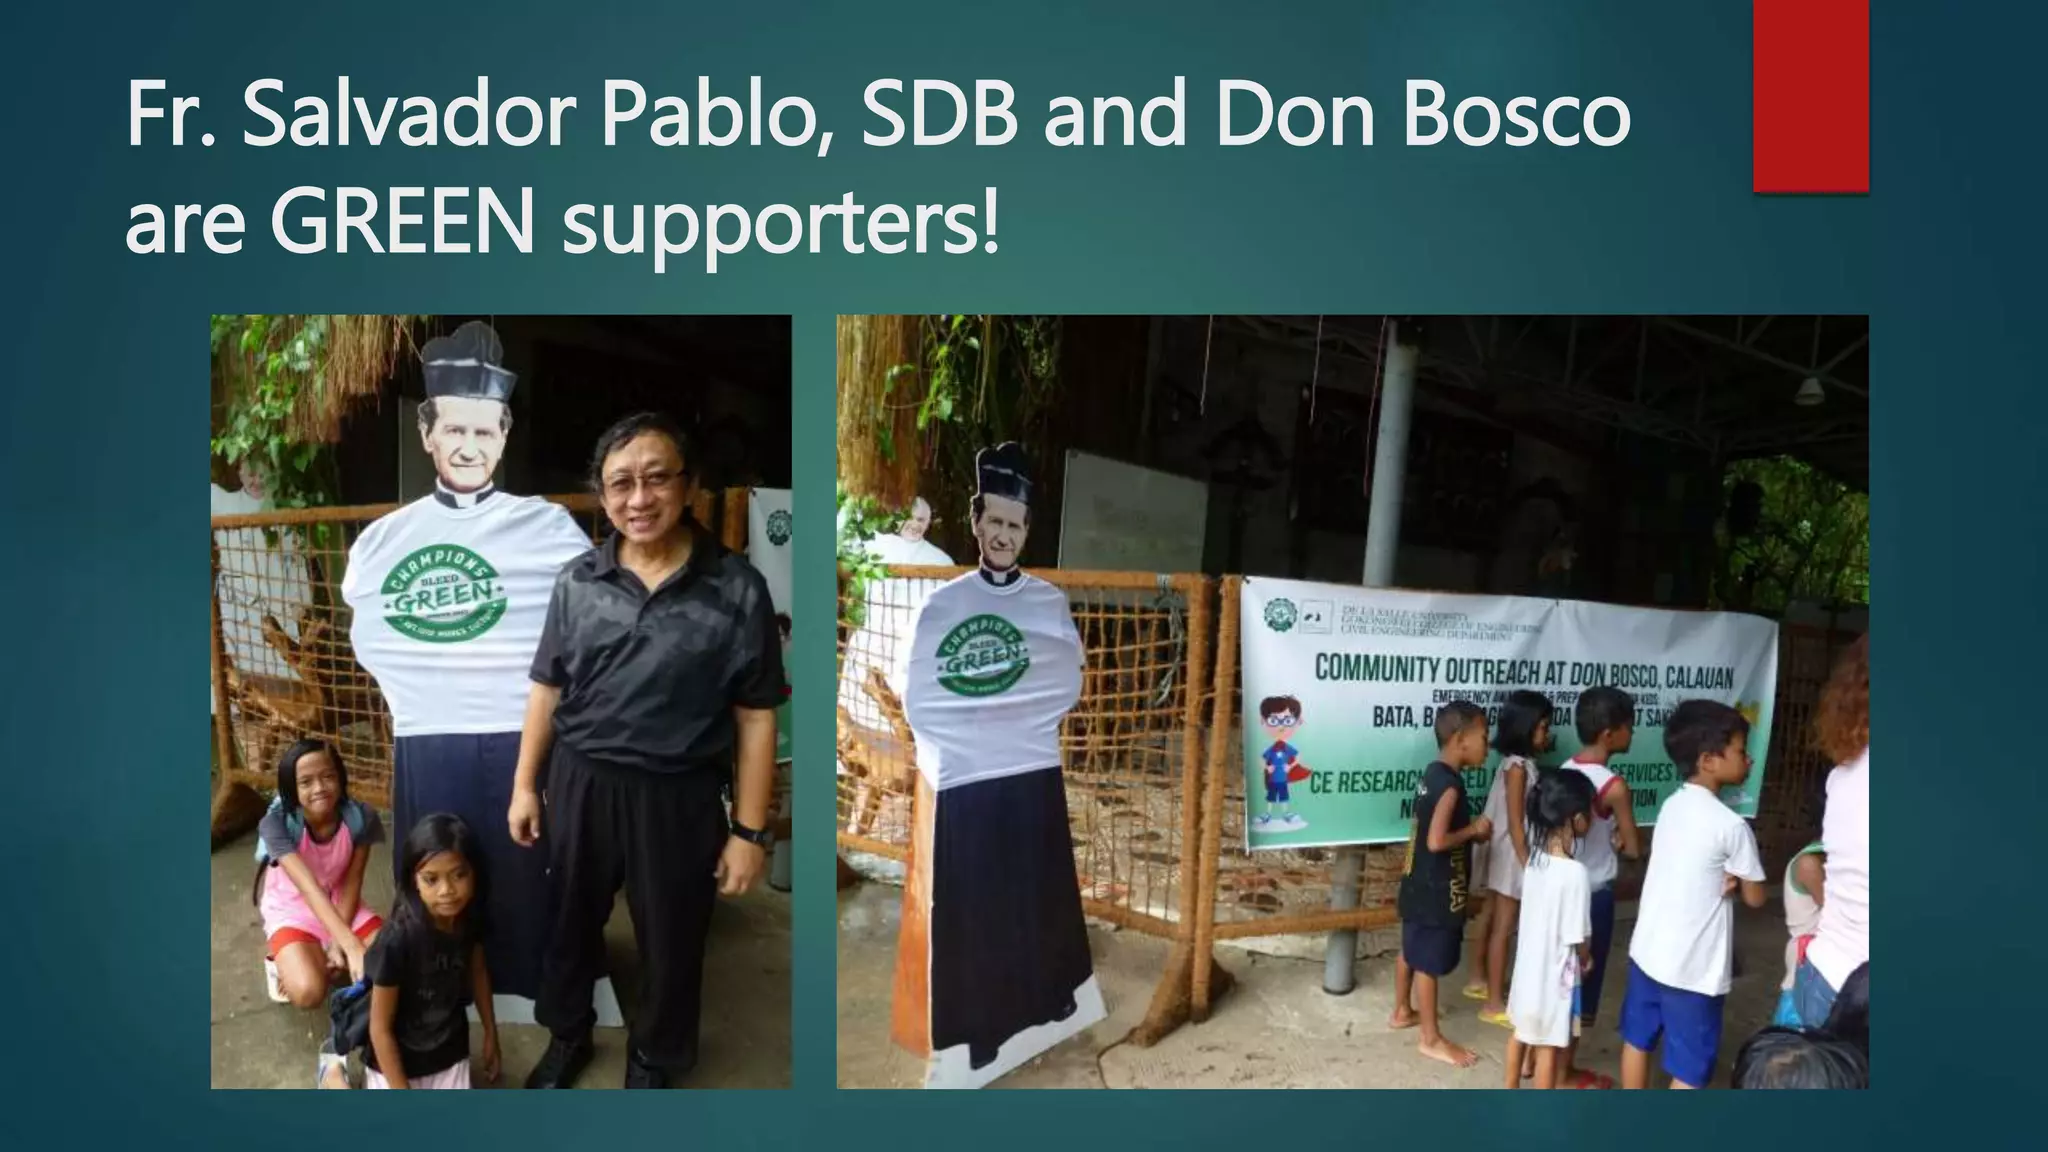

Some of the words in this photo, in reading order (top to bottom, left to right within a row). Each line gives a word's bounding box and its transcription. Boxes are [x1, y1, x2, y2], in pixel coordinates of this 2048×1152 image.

[390, 549, 489, 590] CHAMPIONS
[394, 580, 492, 614] GREEN
[946, 643, 1020, 673] GREEN
[1315, 652, 1441, 682] COMMUNITY
[1445, 657, 1541, 685] OUTREACH
[1544, 660, 1567, 686] AT
[1570, 662, 1606, 686] DON
[1611, 664, 1662, 691] BOSCO,
[1666, 665, 1735, 690] CALAUAN
[1373, 705, 1419, 729] BATA,
[1310, 770, 1334, 794] CE
